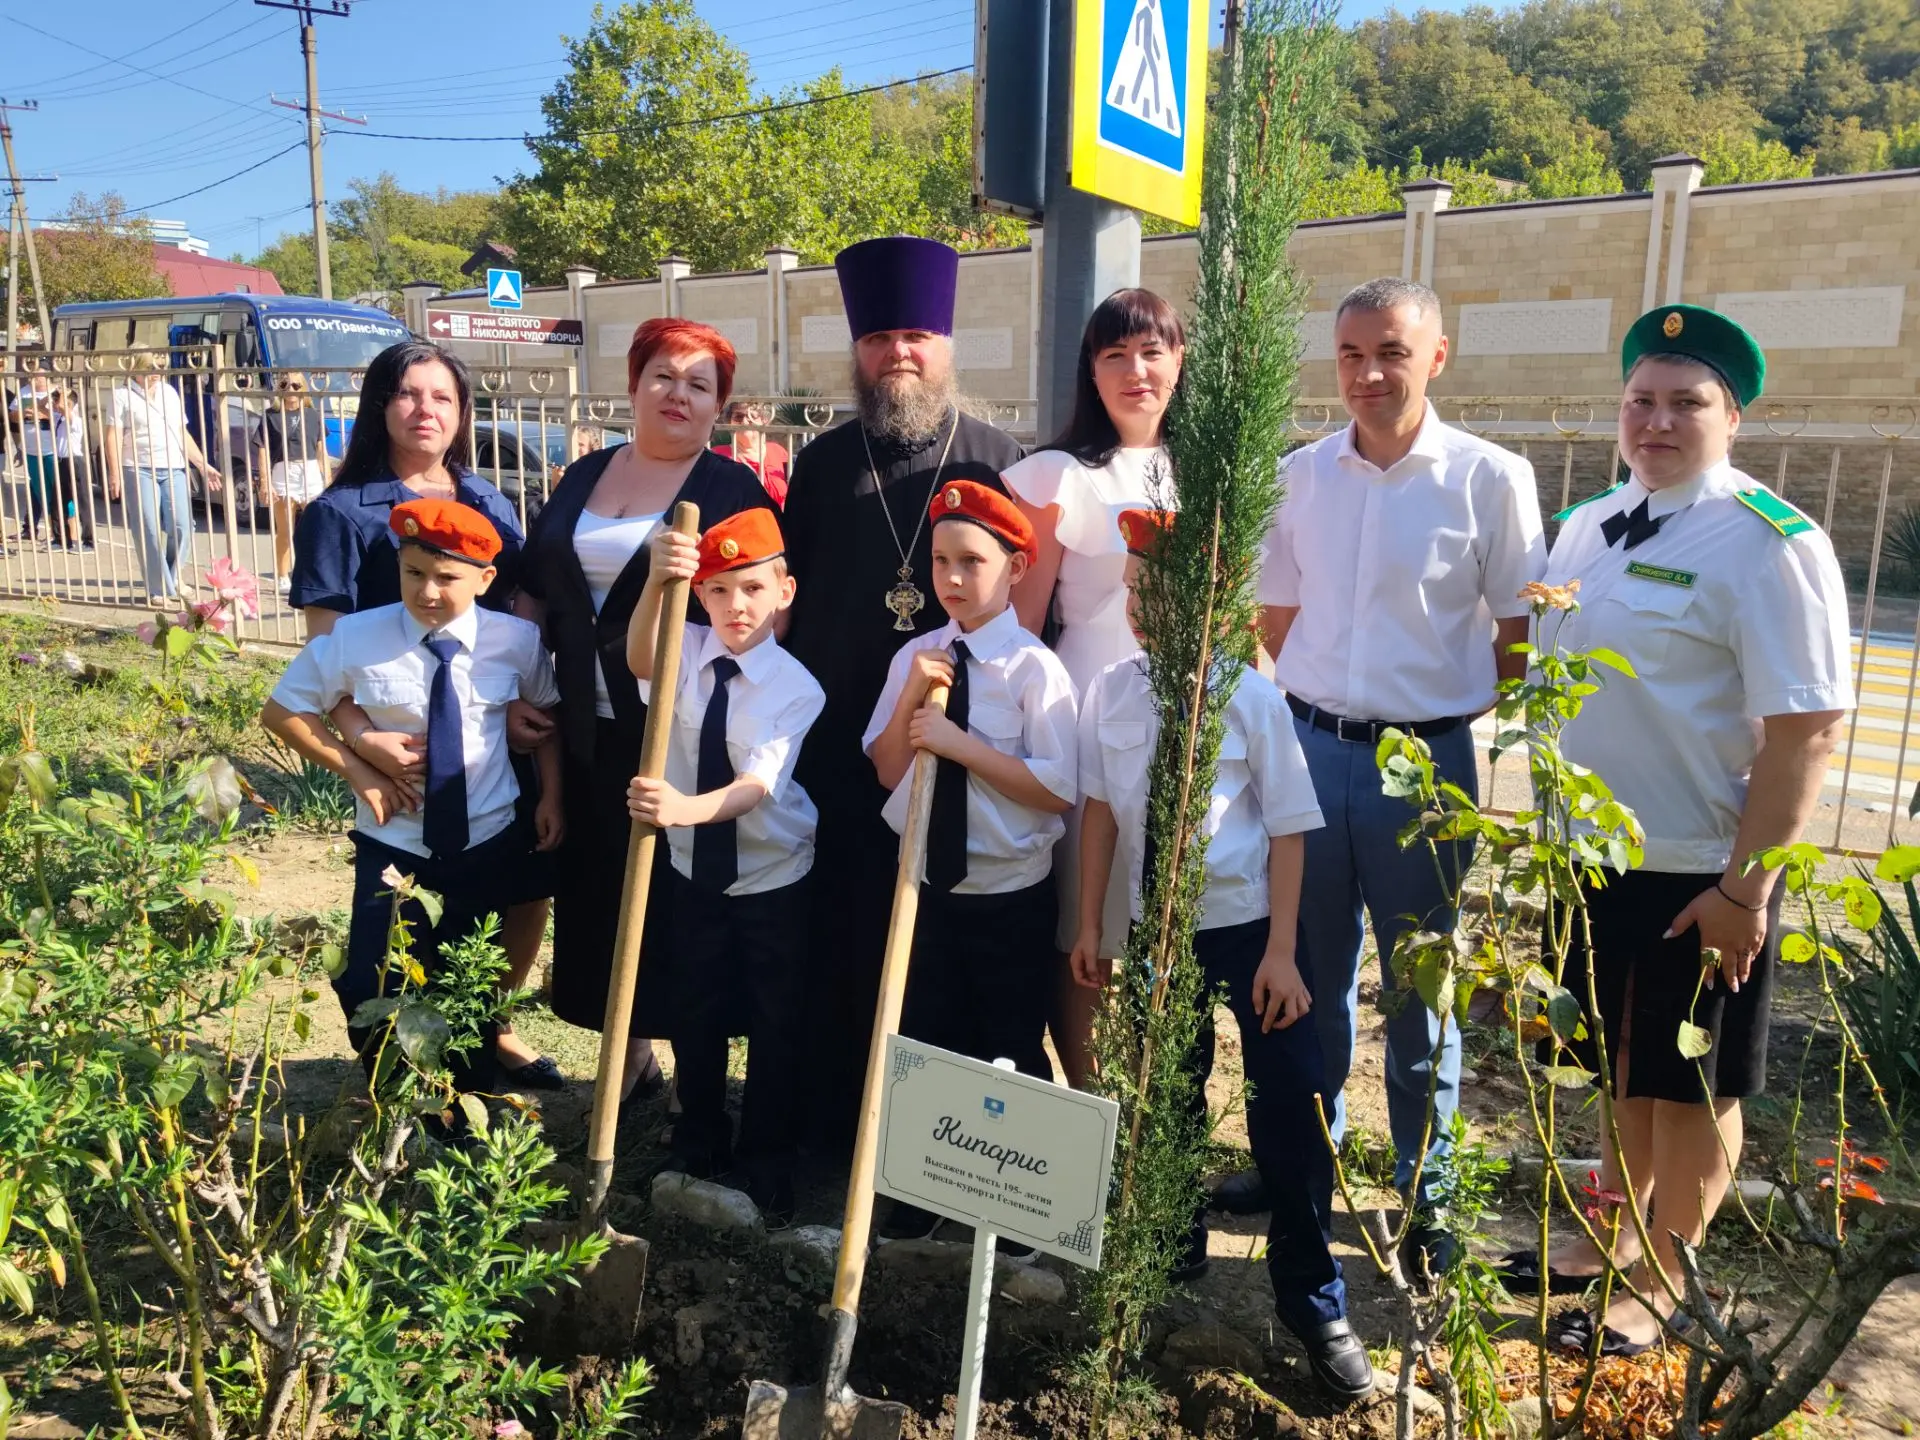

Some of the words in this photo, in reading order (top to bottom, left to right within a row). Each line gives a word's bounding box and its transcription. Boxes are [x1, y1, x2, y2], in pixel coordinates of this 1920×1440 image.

[268, 318, 302, 330] ООО
[472, 317, 496, 327] храм
[497, 317, 541, 329] СВЯТОГО
[472, 328, 519, 340] НИКОЛАЯ
[520, 330, 581, 343] ЧУДОТВОРЦА
[932, 1116, 1048, 1175] Кипарис
[923, 1170, 995, 1200] города-курорта
[997, 1193, 1051, 1219] Геленджик
[925, 1155, 966, 1178] Высажен
[975, 1174, 1001, 1189] честь
[1024, 1192, 1052, 1206] летия
